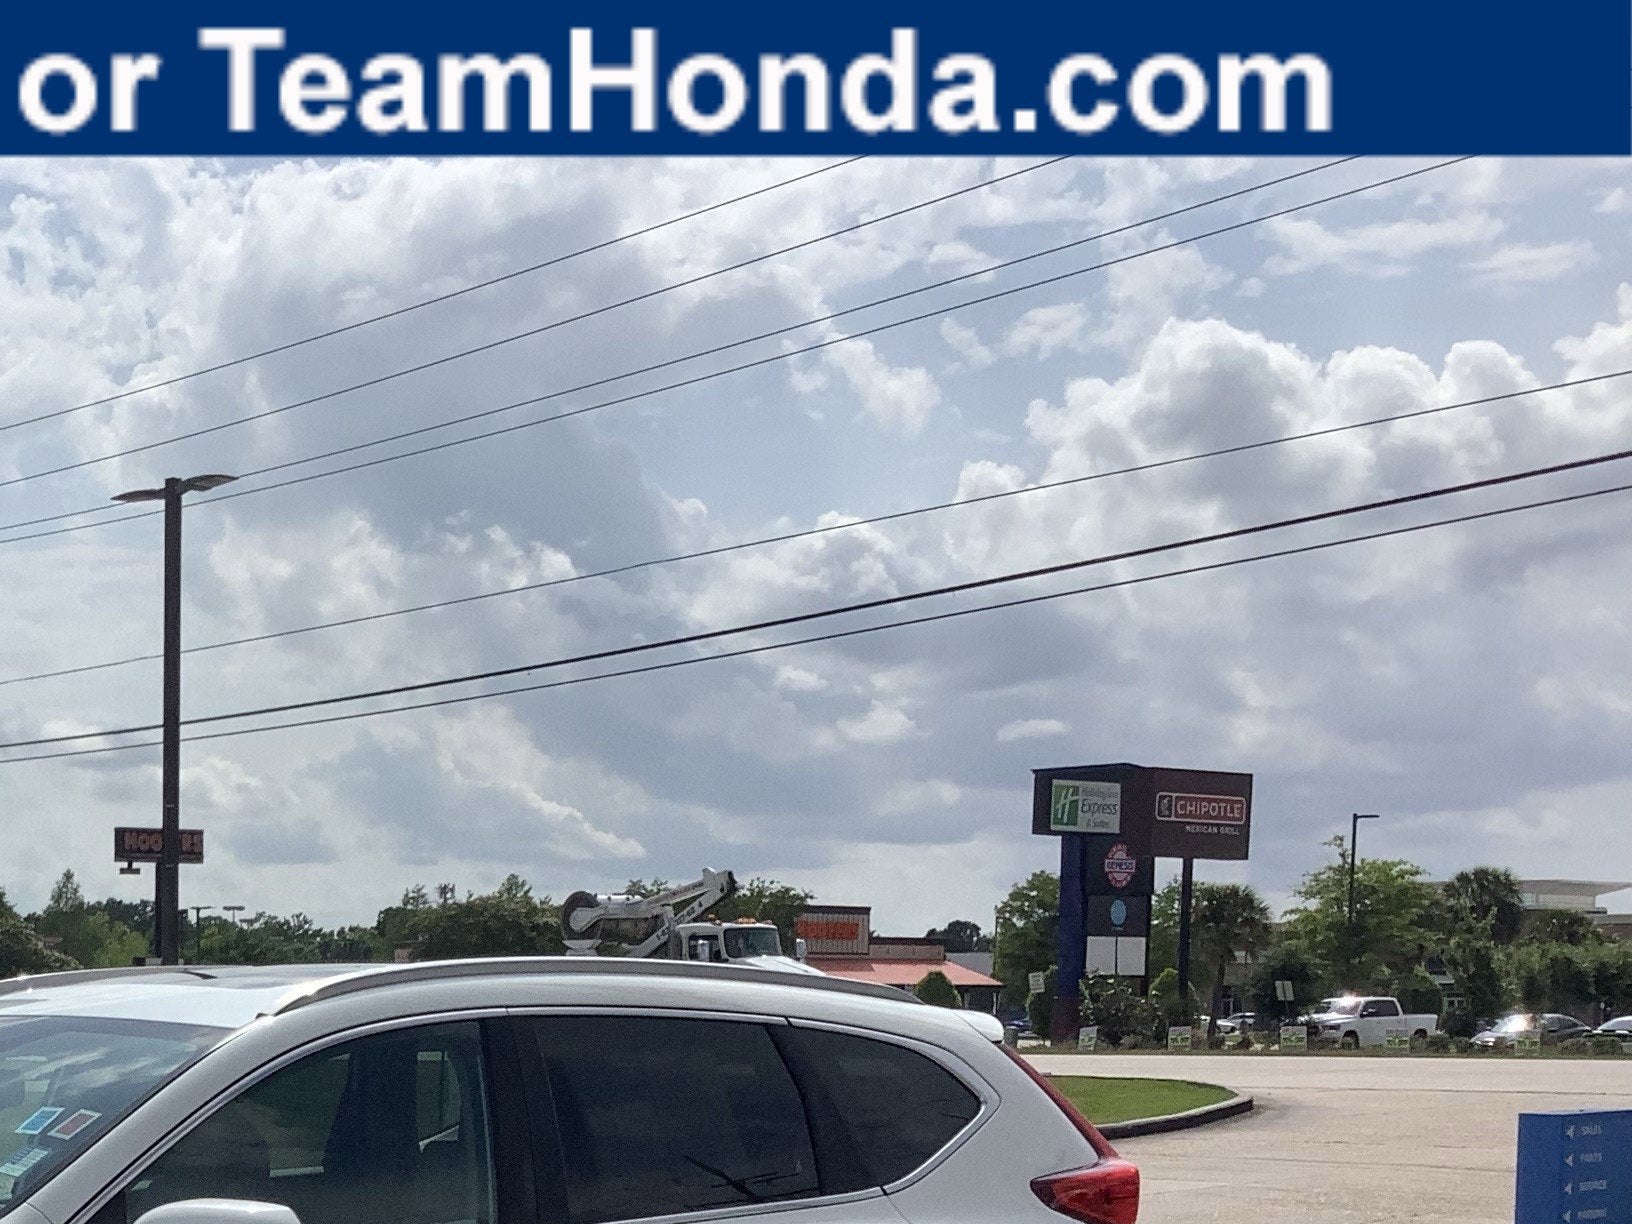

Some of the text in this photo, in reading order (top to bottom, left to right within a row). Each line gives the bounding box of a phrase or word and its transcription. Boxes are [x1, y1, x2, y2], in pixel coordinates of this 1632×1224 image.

[1081, 798, 1118, 817] Express
[1176, 801, 1243, 818] CHIPOTLE
[1185, 825, 1241, 835] MEXICAN GRILL
